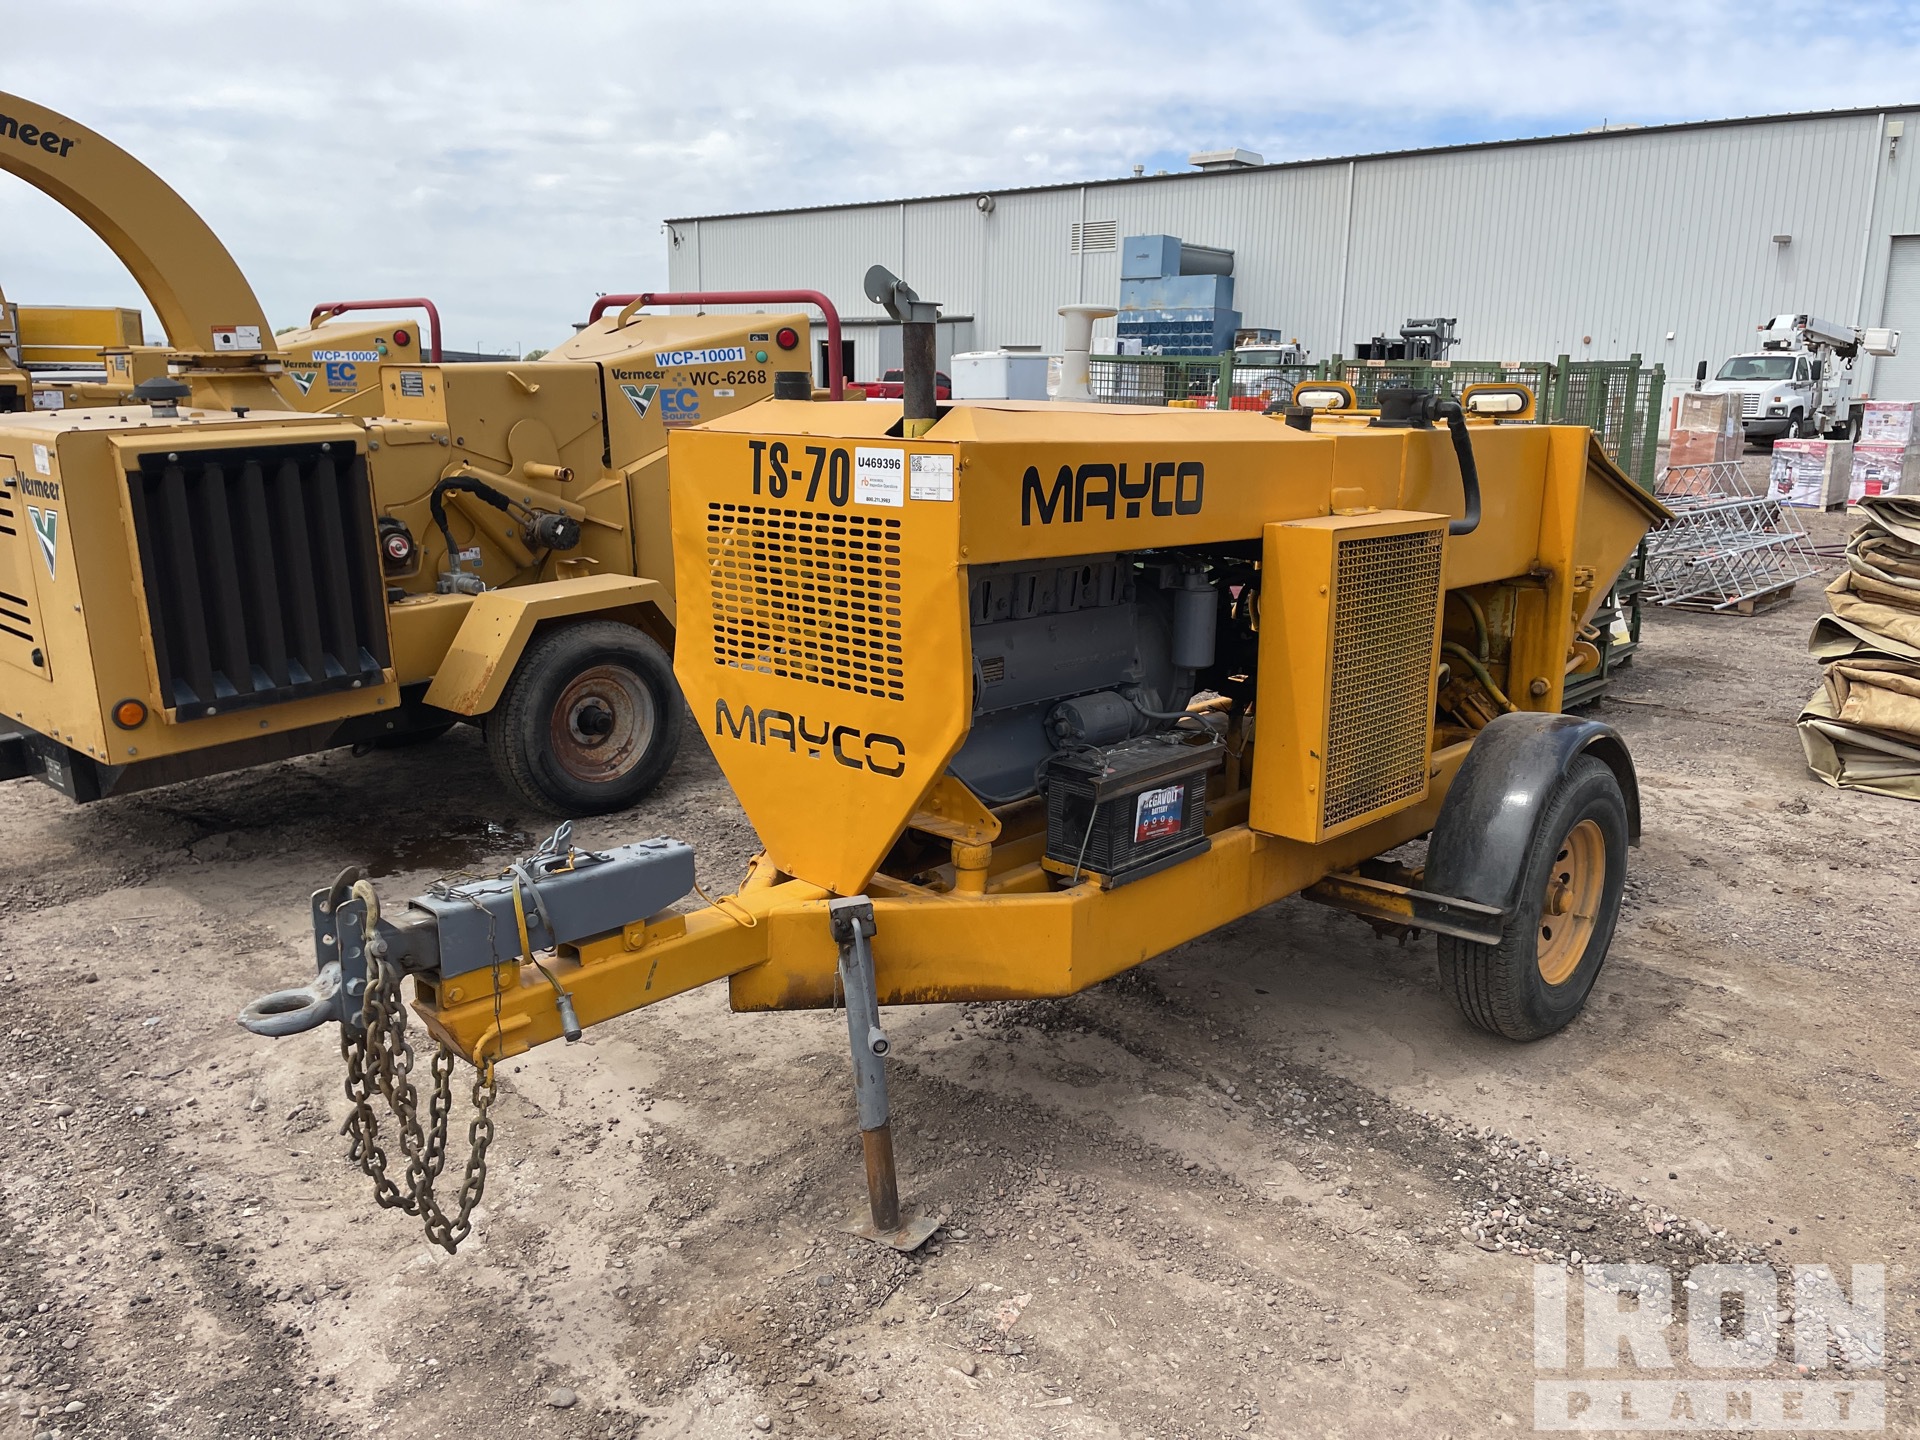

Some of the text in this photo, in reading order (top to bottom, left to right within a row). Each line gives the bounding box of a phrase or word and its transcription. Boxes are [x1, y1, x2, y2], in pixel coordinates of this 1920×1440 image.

[283, 360, 322, 369] Vermeer
[313, 351, 378, 361] WCP-10002
[656, 347, 744, 367] WCP-10001
[326, 362, 357, 381] EC
[611, 368, 665, 380] Vermeer
[689, 370, 767, 386] WC-6268
[659, 388, 699, 413] EC
[661, 411, 700, 420] Source
[858, 457, 901, 469] U469396
[749, 440, 850, 507] TS-70
[17, 470, 60, 501] Vermeer
[1021, 461, 1205, 526] MAYCO
[715, 698, 906, 778] MAYCO
